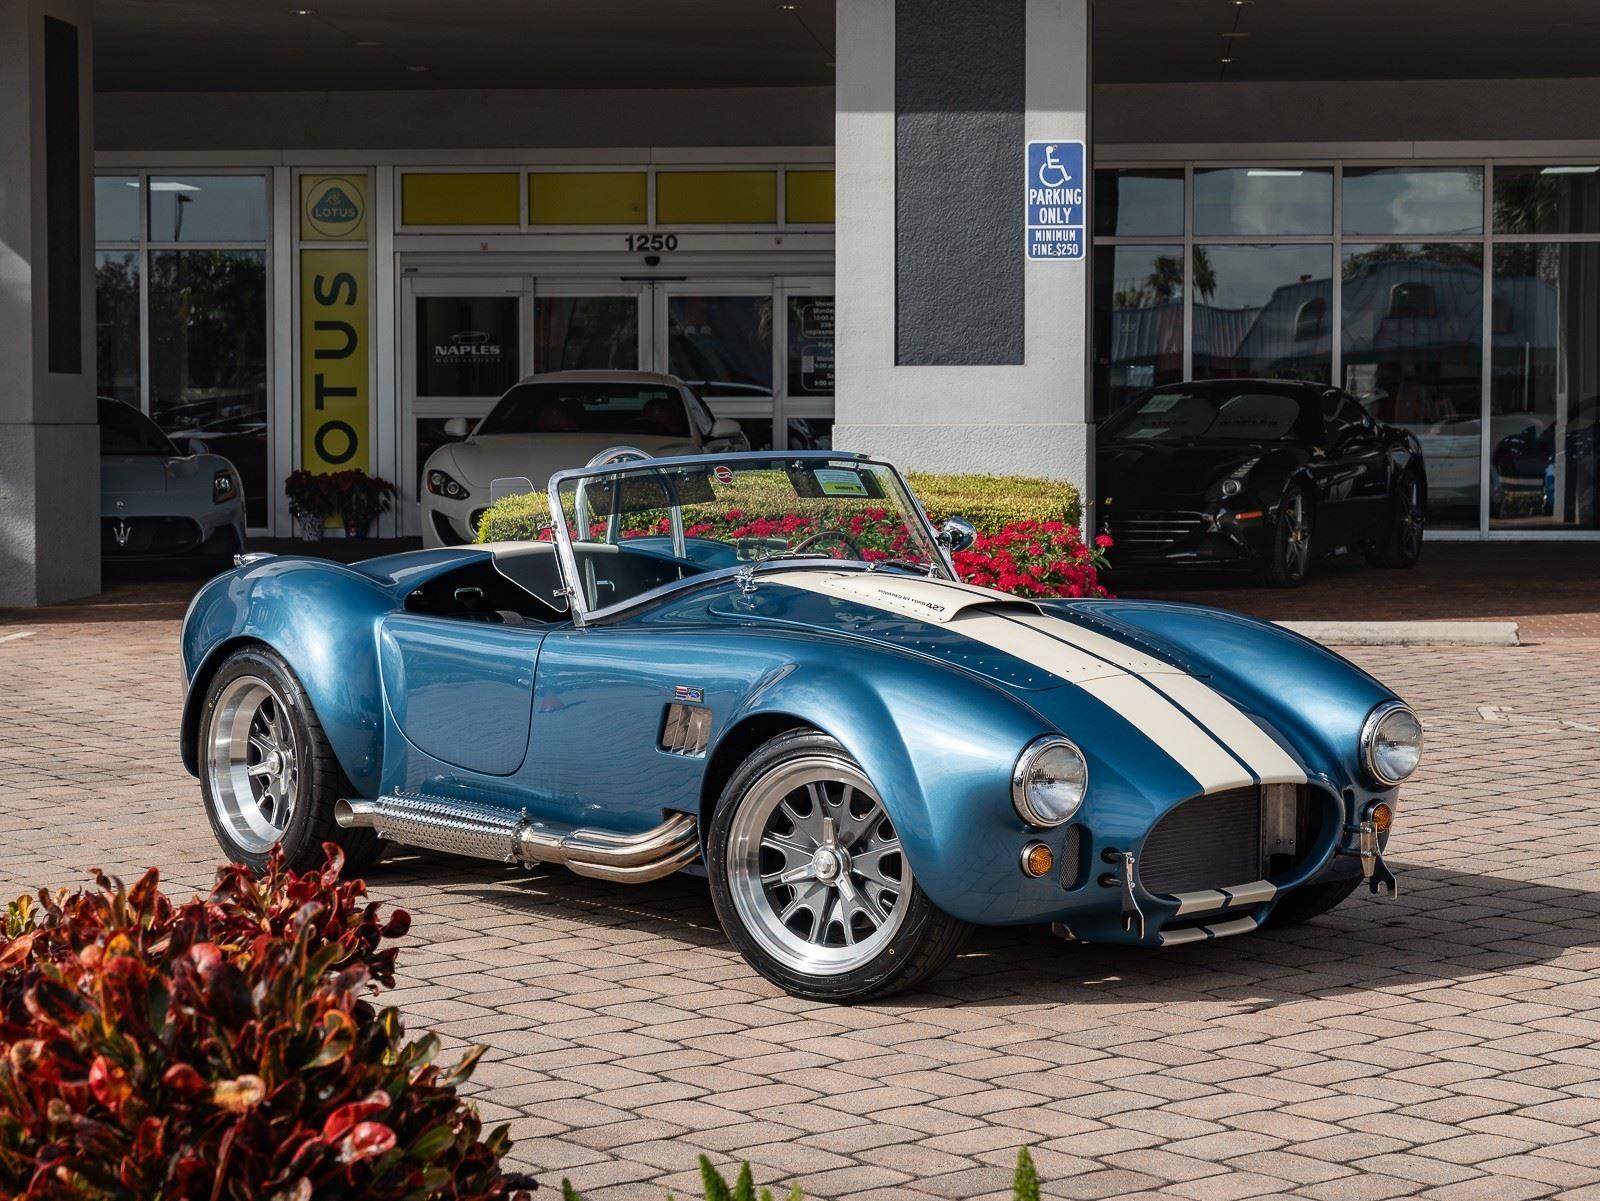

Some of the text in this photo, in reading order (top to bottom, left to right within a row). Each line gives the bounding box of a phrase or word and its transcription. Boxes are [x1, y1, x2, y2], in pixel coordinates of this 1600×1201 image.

[1029, 188, 1082, 206] PARKING
[315, 207, 355, 217] LOTUS
[1039, 207, 1072, 224] ONLY
[625, 233, 678, 251] 1250
[1035, 229, 1076, 242] MINIMUM
[1032, 243, 1079, 256] FINE $250
[435, 345, 500, 356] NAPLES
[313, 272, 358, 464] OTUS
[926, 602, 945, 612] 427
